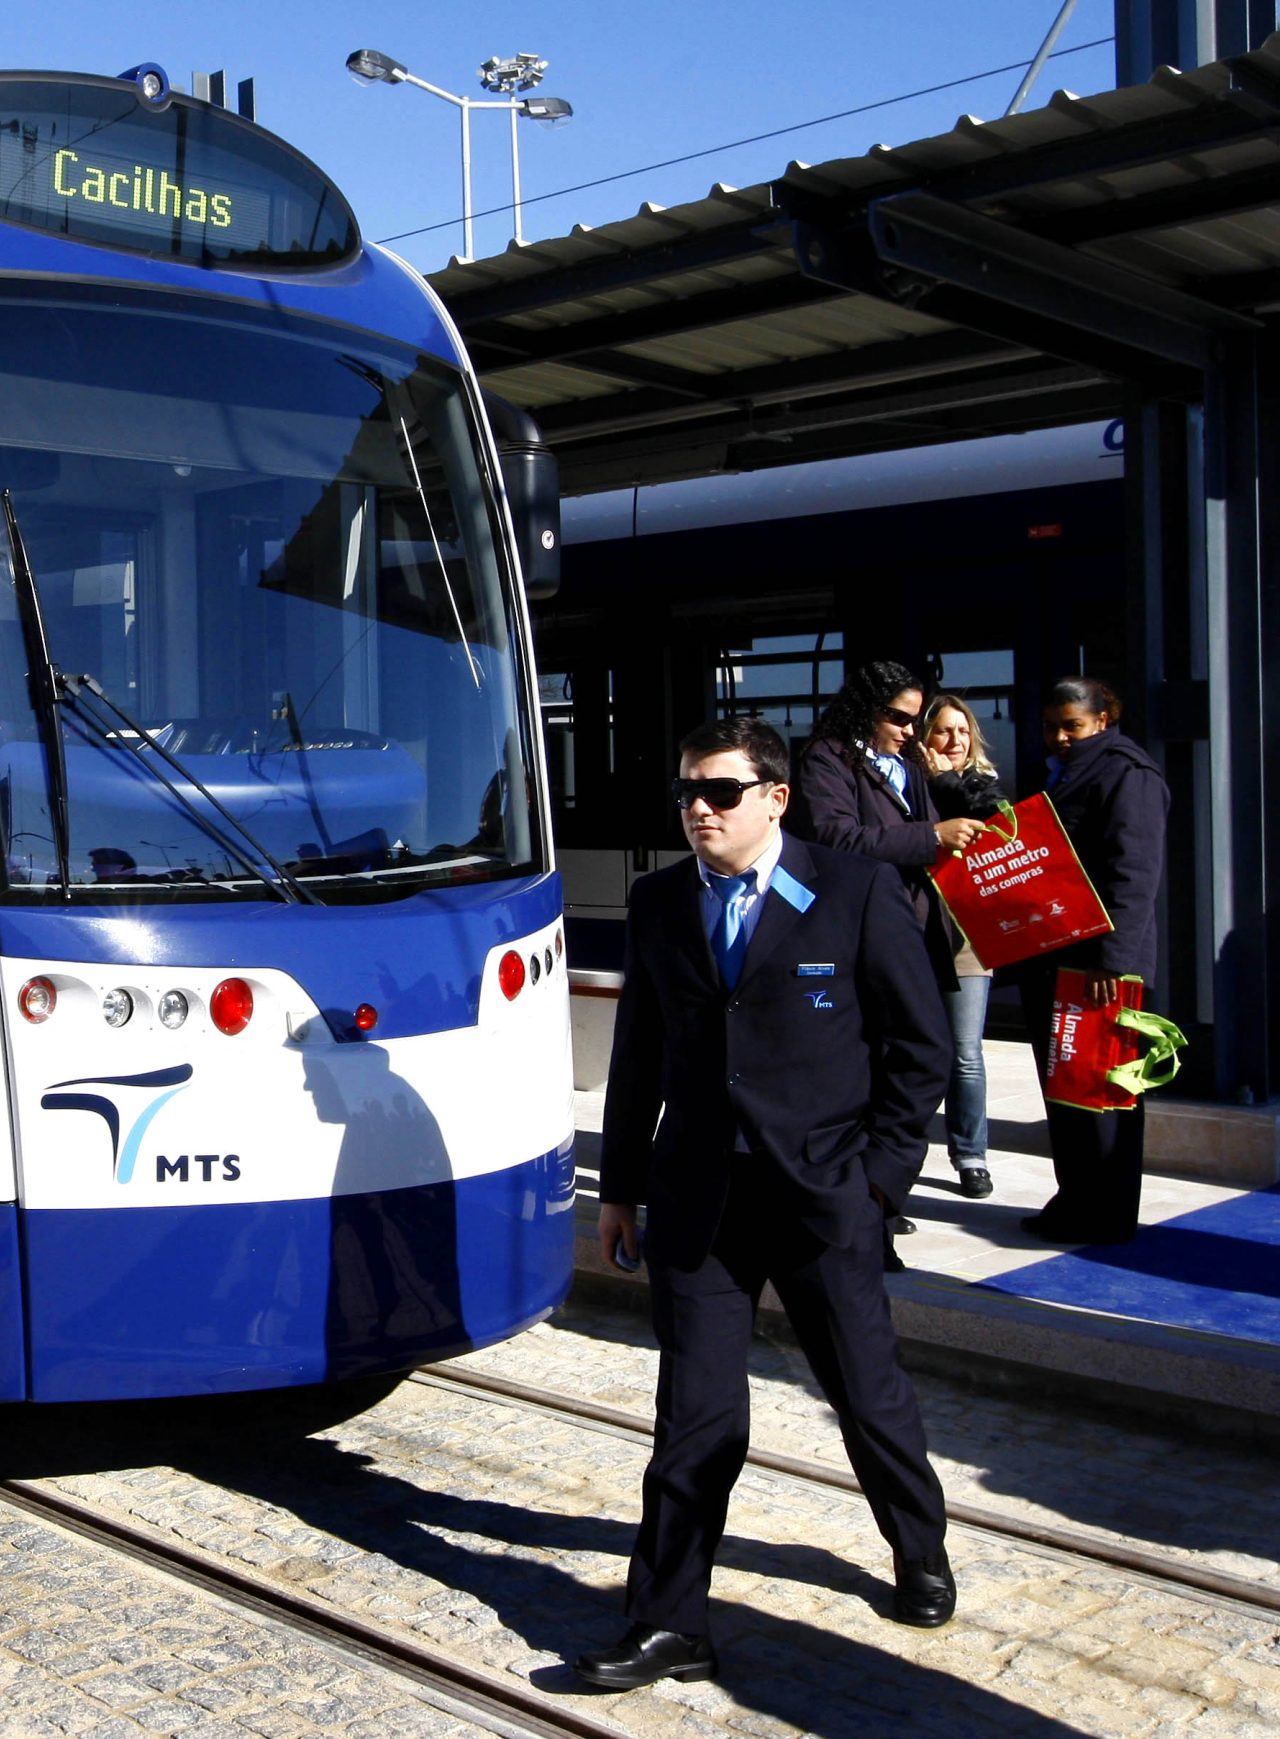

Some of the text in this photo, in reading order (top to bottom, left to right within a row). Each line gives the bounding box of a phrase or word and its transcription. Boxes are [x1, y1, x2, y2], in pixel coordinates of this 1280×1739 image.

[54, 149, 232, 228] Cacilhas
[966, 839, 1026, 871] Almada
[972, 846, 1050, 885] a um metro
[979, 865, 1044, 898] das compras
[1061, 1002, 1083, 1062] Almada
[156, 1154, 241, 1182] MTS
